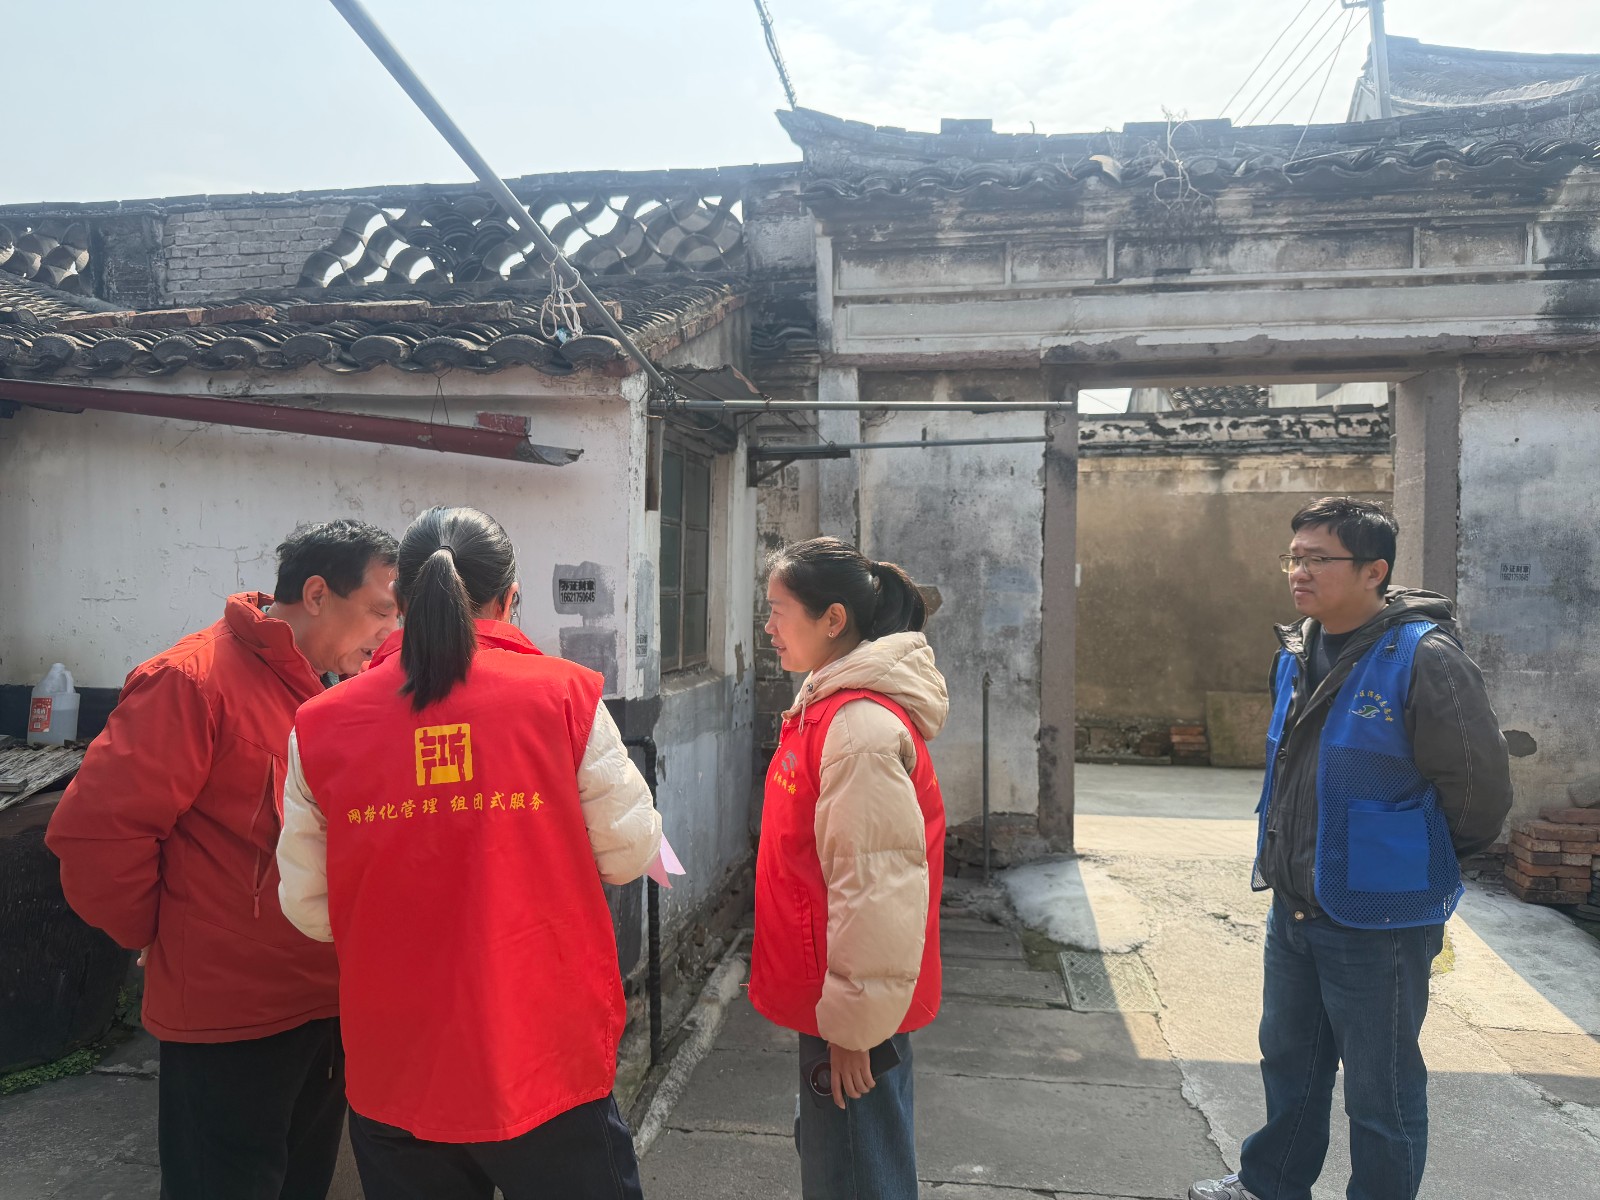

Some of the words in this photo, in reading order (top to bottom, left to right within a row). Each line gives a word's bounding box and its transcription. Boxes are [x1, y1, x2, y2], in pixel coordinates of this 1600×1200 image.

[347, 796, 439, 824] 网格化管理
[450, 791, 544, 811] 组团式服务
